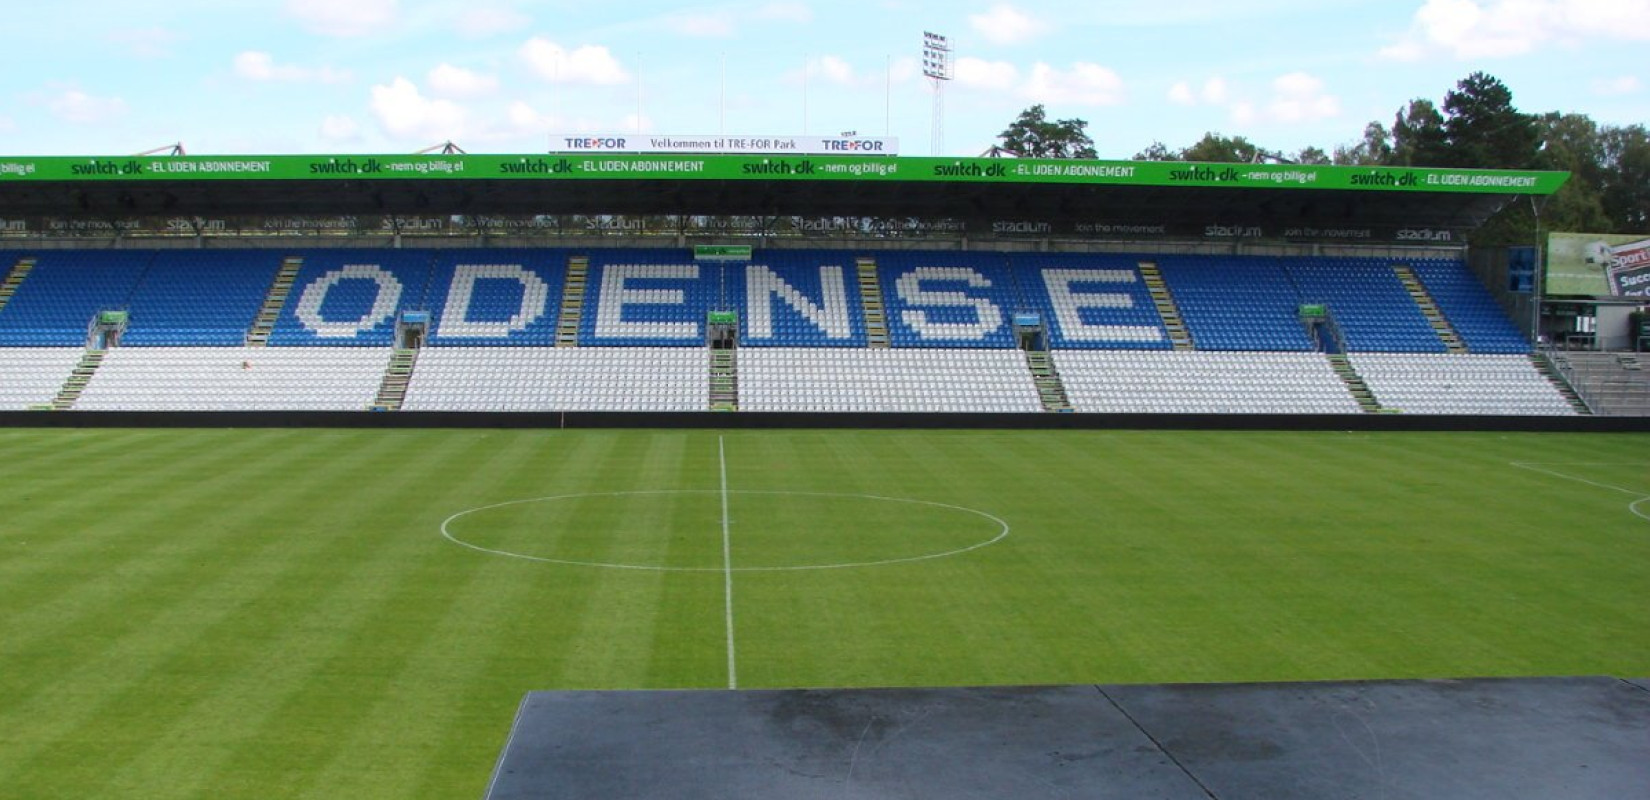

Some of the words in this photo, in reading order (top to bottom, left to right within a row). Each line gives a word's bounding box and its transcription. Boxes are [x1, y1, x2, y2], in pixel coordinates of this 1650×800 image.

[650, 138, 711, 149] Velkommen
[714, 138, 725, 149] til
[728, 139, 771, 149] TRE-FOR
[773, 139, 797, 150] Park
[72, 160, 142, 175] switch.dk
[168, 162, 197, 172] UDEN
[199, 162, 271, 173] ABONNEMENT
[310, 159, 381, 174] switch.dk
[455, 161, 463, 172] el
[500, 158, 573, 174] switch.dk
[599, 161, 628, 172] UDEN
[631, 161, 704, 172] ABONNEMENT
[742, 159, 814, 175] switch.dk
[849, 164, 862, 175] og
[863, 163, 887, 175] billig
[888, 163, 897, 173] el
[934, 161, 1006, 177] switch.dk
[1033, 165, 1062, 176] UDEN
[1063, 166, 1135, 178] ABONNEMENT
[1169, 166, 1238, 182] switch.dk
[1350, 171, 1417, 187] switch.dk
[1440, 174, 1468, 186] UDEN
[1469, 175, 1536, 188] ABONNEMENT
[992, 221, 1051, 234] stadium
[294, 264, 1163, 341] ODENSE
